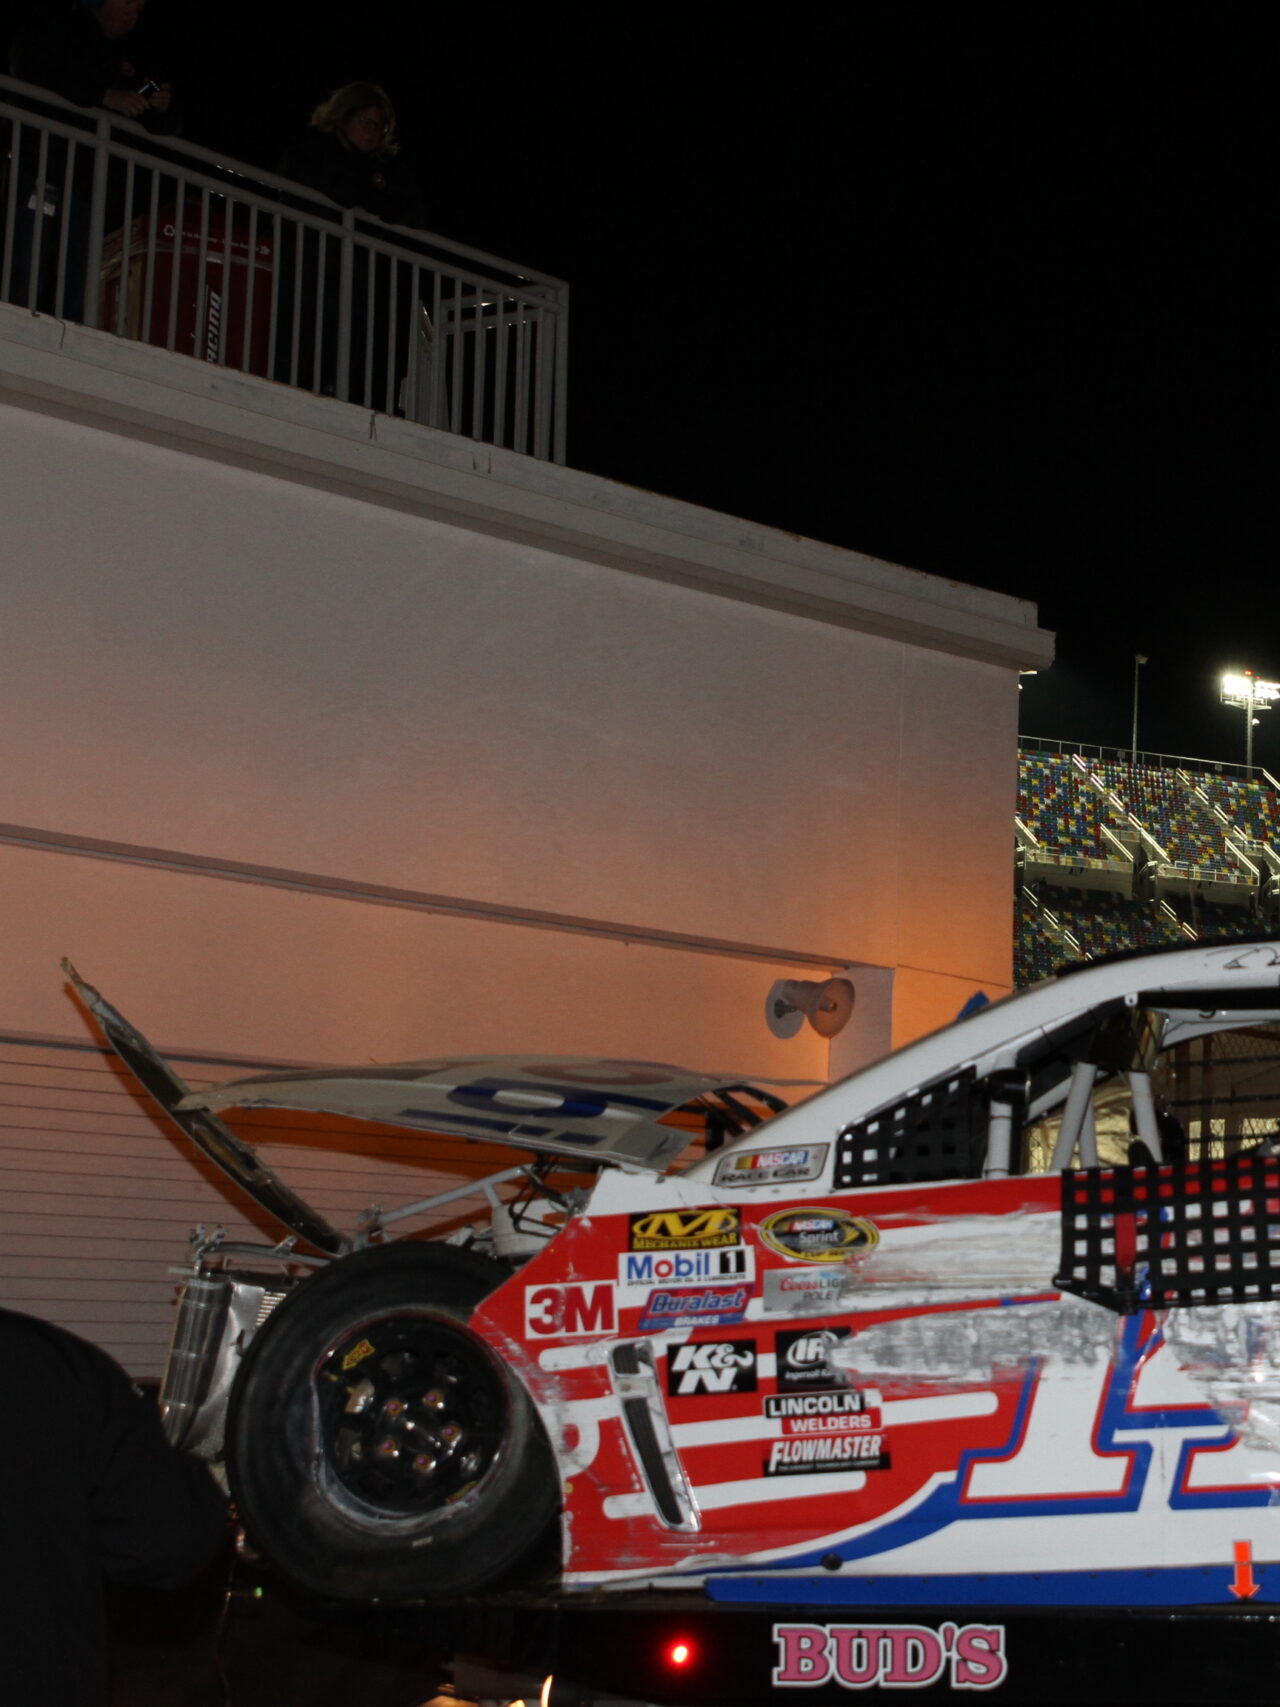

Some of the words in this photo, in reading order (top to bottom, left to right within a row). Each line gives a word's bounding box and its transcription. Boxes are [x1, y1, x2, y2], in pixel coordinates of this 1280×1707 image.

[757, 1151, 809, 1170] NASCAR
[720, 1170, 768, 1183] RACE
[772, 1168, 812, 1178] CAR
[791, 1219, 836, 1232] NASCAR
[701, 1232, 738, 1248] WEAR
[799, 1230, 839, 1244] Sprint
[627, 1252, 709, 1280] Mobil
[528, 1283, 615, 1336] 3M
[650, 1289, 746, 1314] Duralast
[673, 1315, 720, 1327] BRAKES
[769, 1393, 862, 1417] LINCOLN
[789, 1414, 873, 1433] WELDERS
[768, 1435, 882, 1474] FLOWMASTER
[772, 1621, 1008, 1690] BUD'S
